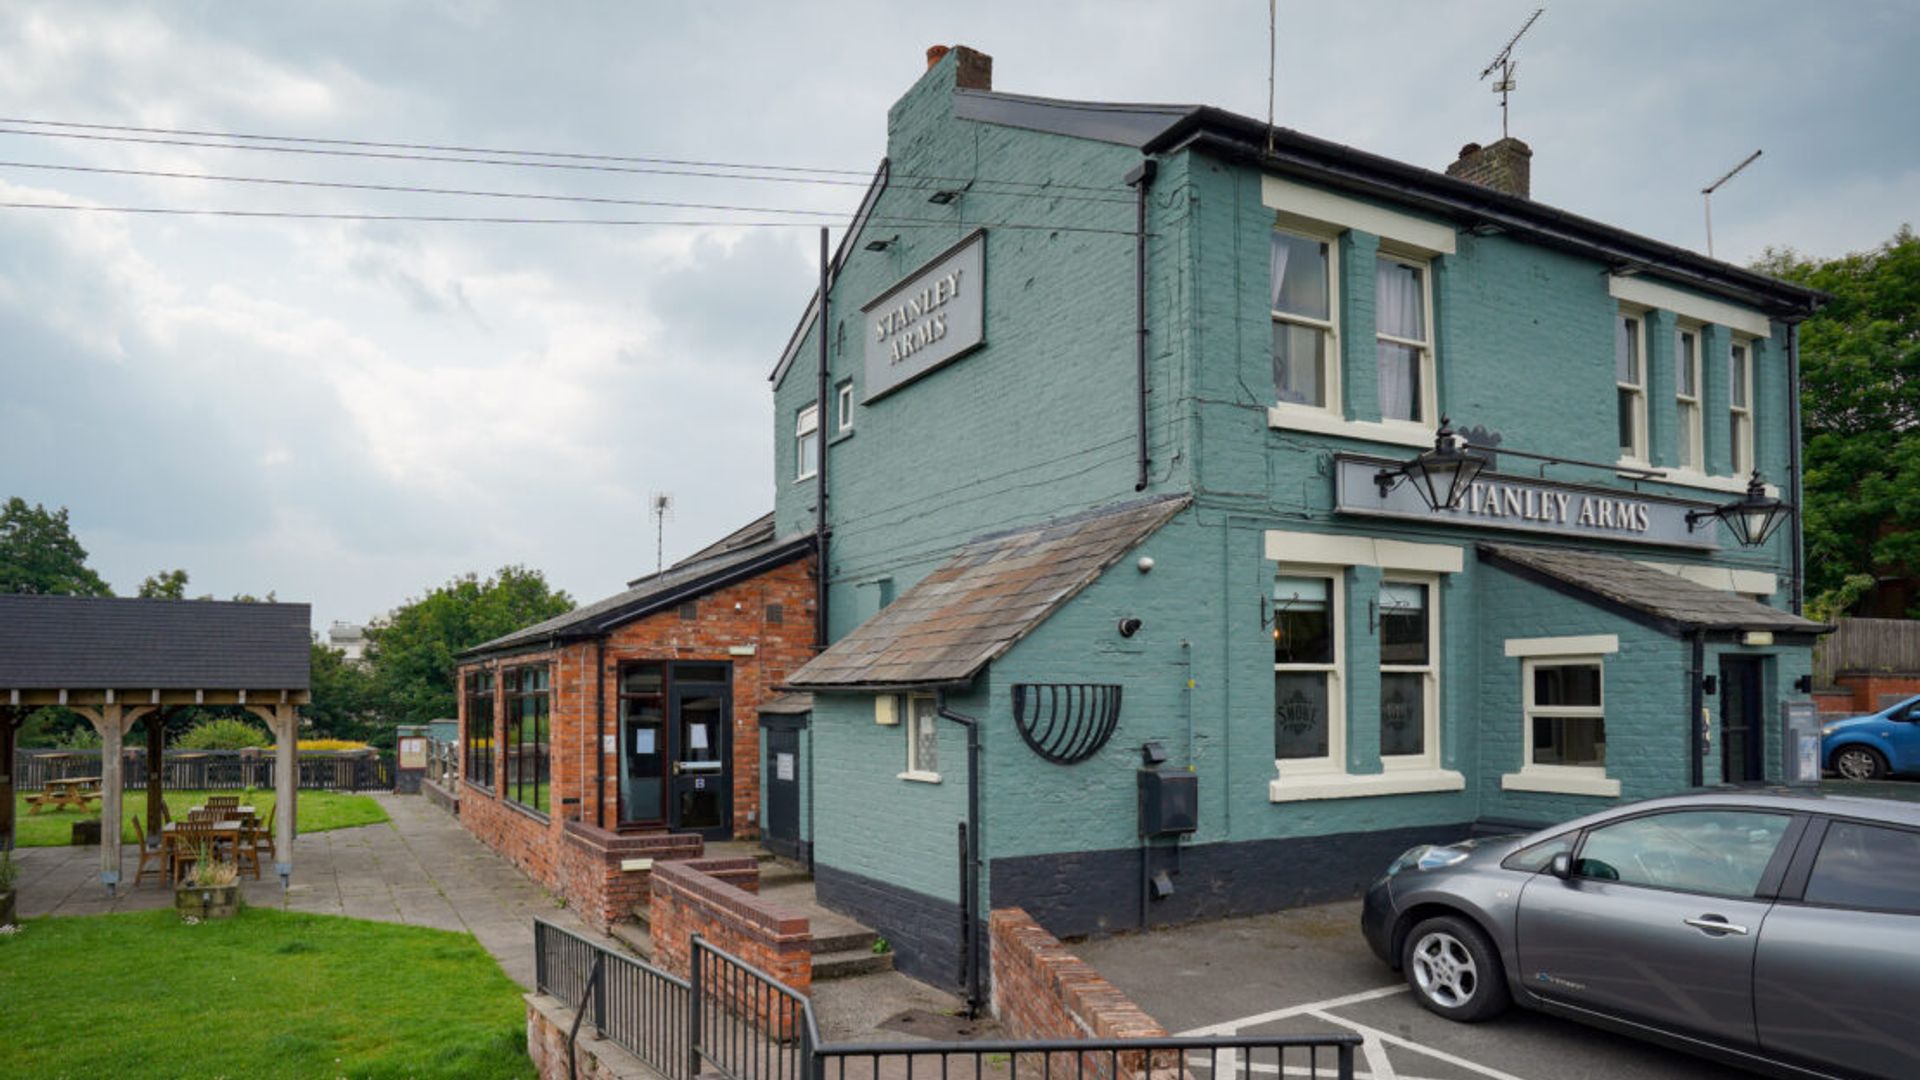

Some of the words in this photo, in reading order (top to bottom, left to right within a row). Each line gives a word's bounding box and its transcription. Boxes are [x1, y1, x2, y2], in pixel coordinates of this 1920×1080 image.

[876, 268, 962, 342] STANLEY
[889, 312, 947, 364] ARMS
[1577, 496, 1650, 532] ARMS
